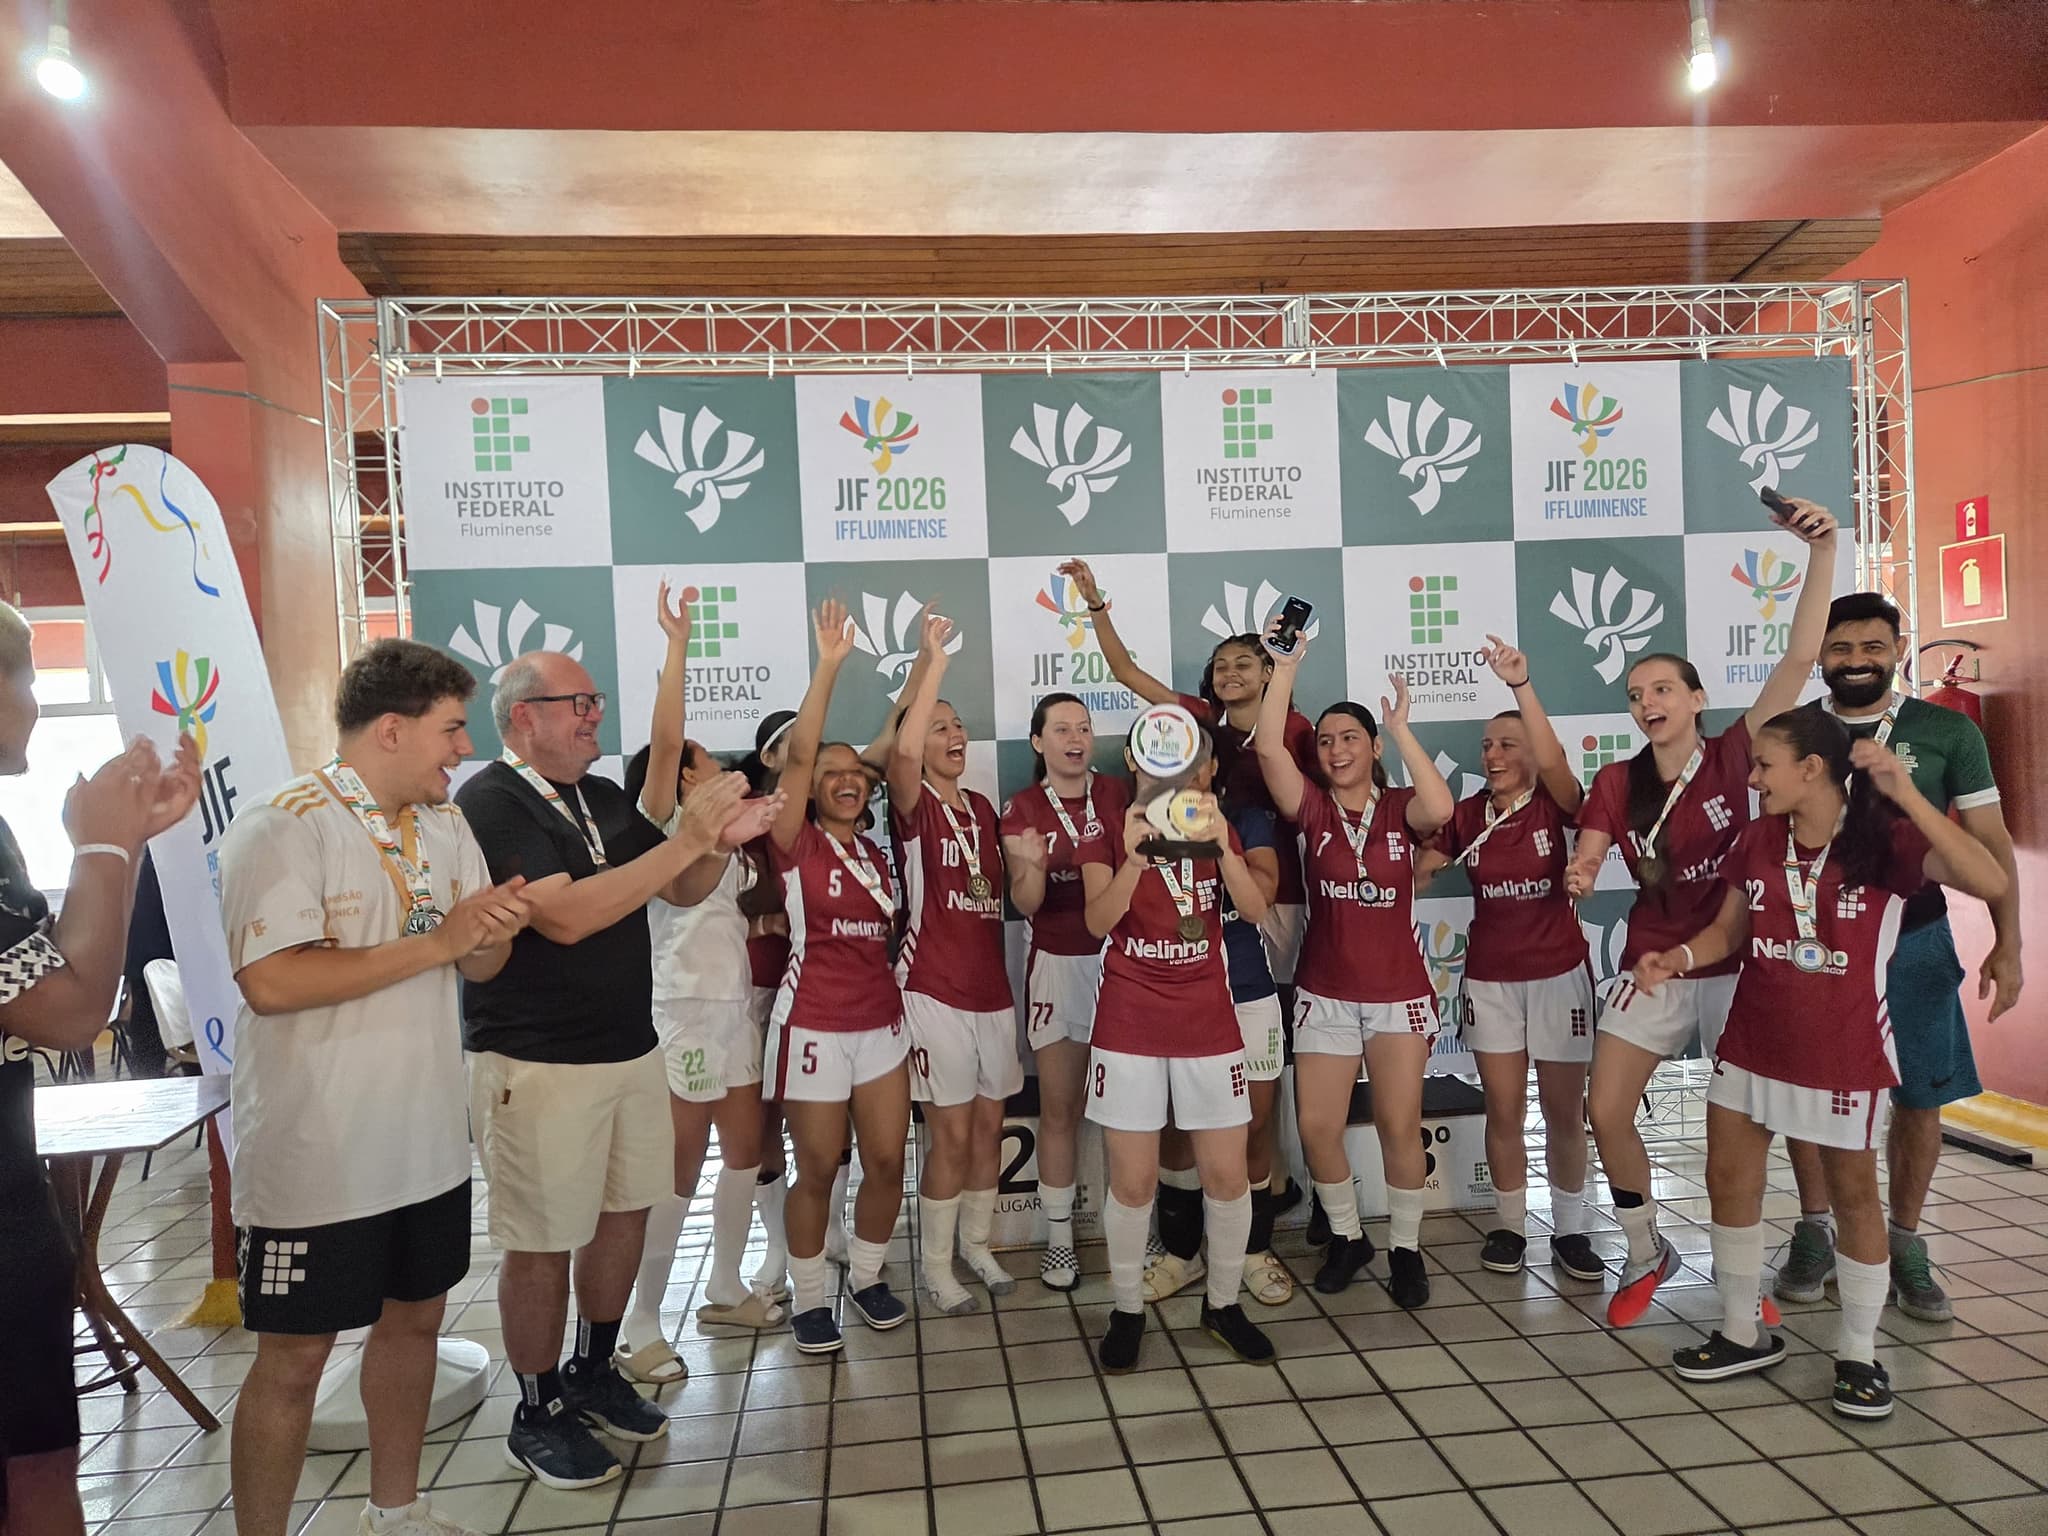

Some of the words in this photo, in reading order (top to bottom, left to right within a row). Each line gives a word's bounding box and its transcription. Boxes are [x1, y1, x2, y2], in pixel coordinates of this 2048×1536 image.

[1197, 465, 1302, 485] INSTITUTO
[1544, 459, 1577, 492] JIF
[1583, 457, 1648, 491] 2026
[444, 480, 565, 499] INSTITUTO
[834, 477, 870, 512] JIF
[876, 475, 946, 511] 2026
[1207, 484, 1294, 502] FEDERAL
[457, 499, 555, 518] FEDERAL
[1210, 506, 1292, 520] Fluminense
[1544, 497, 1648, 520] IFFLUMINENSE
[460, 522, 553, 537] Fluminense
[835, 518, 948, 541] IFFLUMINENSE
[1725, 624, 1757, 657] JIF
[1762, 622, 1793, 655] 20
[1030, 652, 1065, 687] JIF
[1070, 649, 1138, 685] 20
[1384, 650, 1487, 671] INSTITUTO
[656, 665, 772, 686] ISTITUTO
[1396, 668, 1480, 687] EDERAL
[684, 684, 763, 703] EDERAL
[1409, 690, 1478, 704] uminense
[684, 707, 760, 721] uminense
[200, 755, 238, 846] JIF
[940, 837, 960, 868] 10
[1316, 831, 1333, 857] 7
[828, 868, 842, 897] 5
[1320, 879, 1397, 901] Nelio
[1481, 878, 1552, 899] Nelinho
[1752, 937, 1849, 968] Nelo
[1297, 1000, 1312, 1028] 7
[681, 1047, 706, 1077] 22
[801, 1041, 818, 1075] 5
[1095, 1062, 1106, 1098] 8
